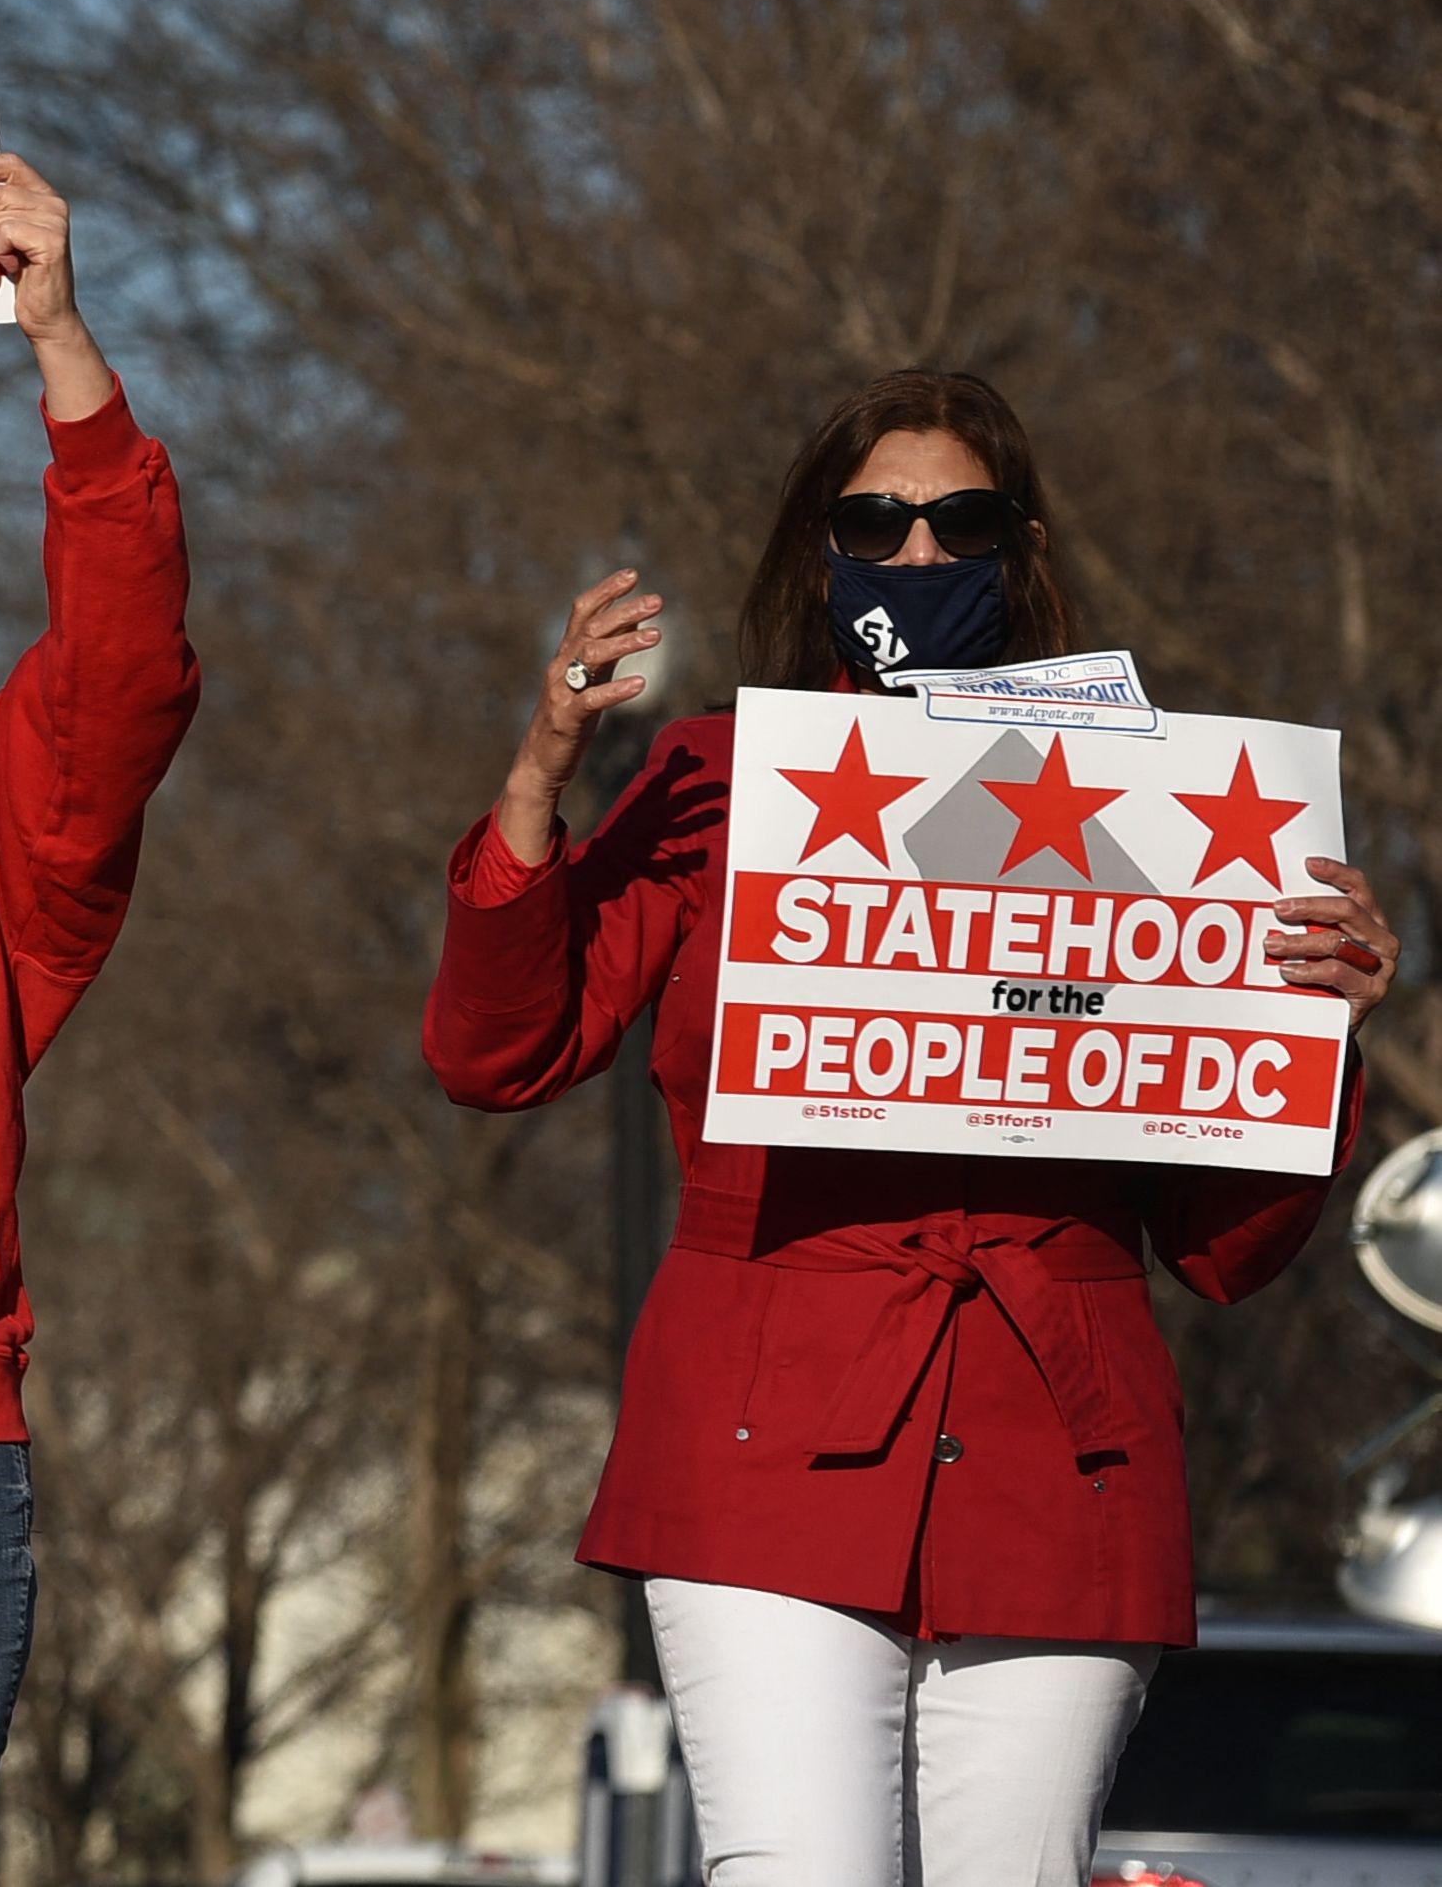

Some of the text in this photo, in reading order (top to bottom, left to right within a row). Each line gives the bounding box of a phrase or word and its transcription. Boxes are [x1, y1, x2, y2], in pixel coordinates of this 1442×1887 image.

[861, 620, 902, 658] 51
[1045, 667, 1071, 681] DC
[991, 979, 1105, 1015] for the
[754, 1013, 1292, 1119] PEOPLE OF DC
[801, 1104, 1243, 1141] @51stDC @51for51 @DC_Vote
